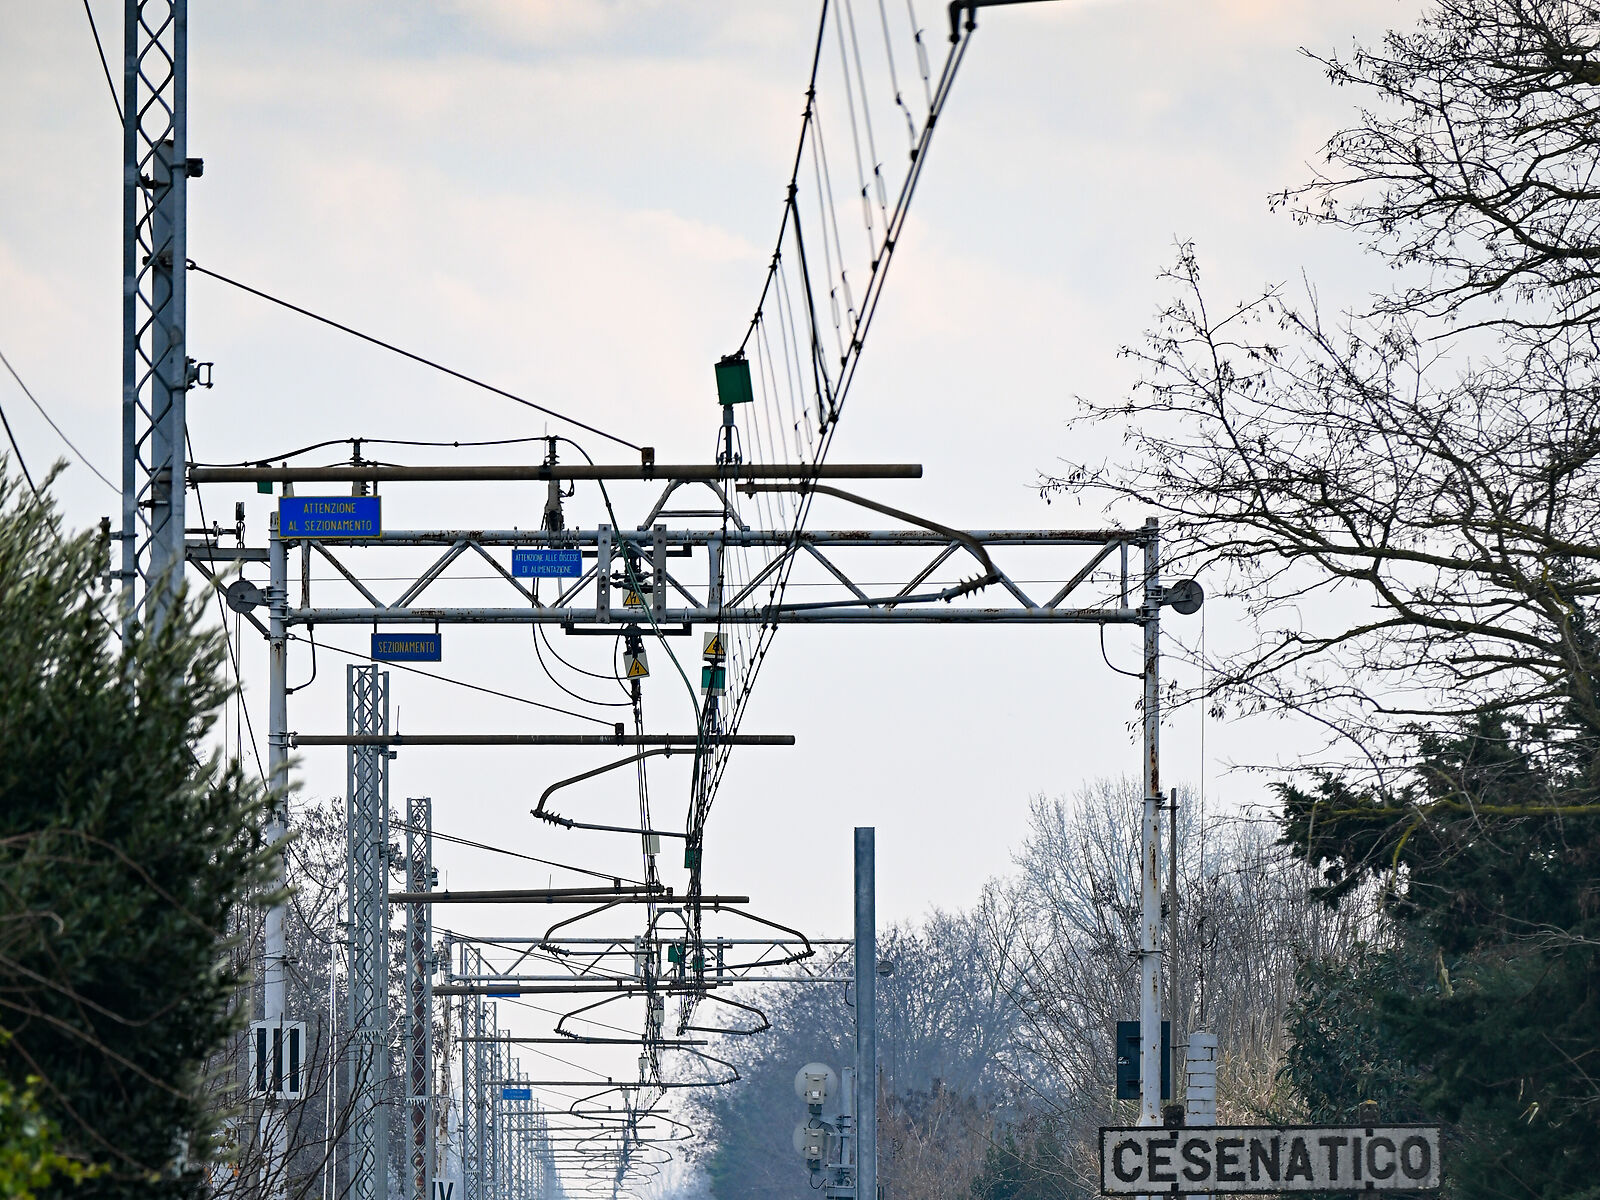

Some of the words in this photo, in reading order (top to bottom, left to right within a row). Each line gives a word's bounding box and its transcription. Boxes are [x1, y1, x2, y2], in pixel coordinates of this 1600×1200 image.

[304, 502, 357, 514] ATTENZIONE
[288, 520, 299, 531] AL
[304, 520, 372, 531] SEZIONAMENTO
[515, 553, 544, 562] ATTENZIONE
[545, 553, 558, 562] ALLE
[522, 565, 528, 574] DI
[530, 565, 572, 574] ALIMENTAZIONE
[378, 641, 435, 653] SEZIONAMENTO
[1112, 1136, 1432, 1183] CESENATICO
